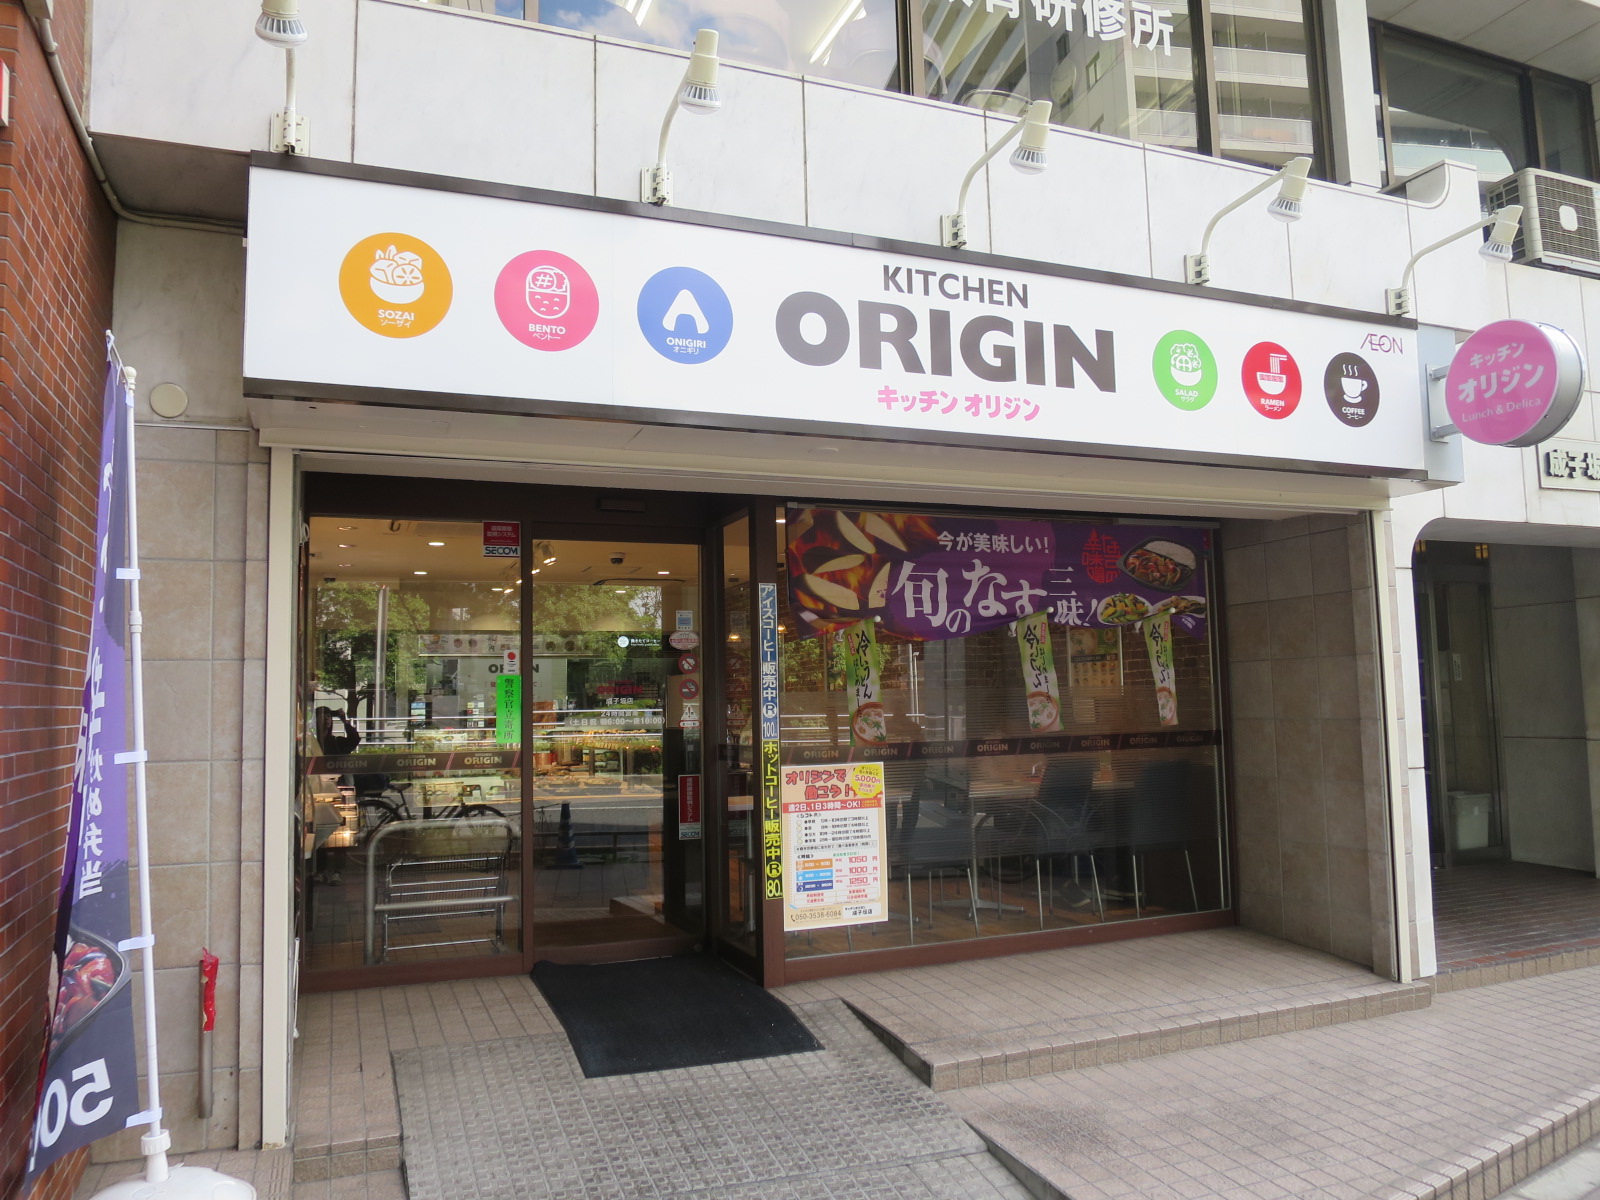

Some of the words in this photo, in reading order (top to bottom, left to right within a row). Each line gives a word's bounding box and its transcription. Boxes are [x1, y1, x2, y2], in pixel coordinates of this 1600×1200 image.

[883, 264, 1028, 309] KITCHEN
[378, 309, 415, 321] SOZAI
[380, 318, 412, 329] ソーザイ
[528, 323, 566, 335] BENTO
[666, 337, 707, 349] ONIGIRI
[775, 291, 1117, 393] ORIGIN
[673, 346, 699, 355] オニギリ
[1470, 343, 1525, 369] キッチン
[1458, 363, 1545, 404] オリジン
[1175, 388, 1199, 398] SALAD
[877, 385, 958, 415] キッチン
[965, 393, 1040, 422] オリジン
[1260, 398, 1285, 407] RAMEN
[1342, 406, 1365, 416] COFFEE
[1462, 408, 1493, 423] Lunch
[1495, 405, 1504, 415] &
[1506, 398, 1542, 413] Delica
[936, 530, 1051, 554] 今が美味しい!
[485, 546, 518, 556] SECOM
[760, 585, 776, 701] アイスコーヒー販売中
[503, 678, 514, 740] 警察官立寄所
[976, 743, 1009, 752] ORIGIN
[1080, 739, 1110, 748] ORIGIN
[803, 750, 839, 759] ORIGIN
[863, 748, 898, 757] ORIGIN
[327, 760, 368, 769] ORIGIN
[396, 758, 437, 767] ORIGIN
[464, 756, 503, 765] ORIGIN
[785, 769, 847, 785] オリジンで
[763, 741, 781, 861] ホットコーヒー販売中
[848, 856, 867, 864] 1050
[849, 866, 868, 874] 1000
[849, 876, 868, 885] 1250
